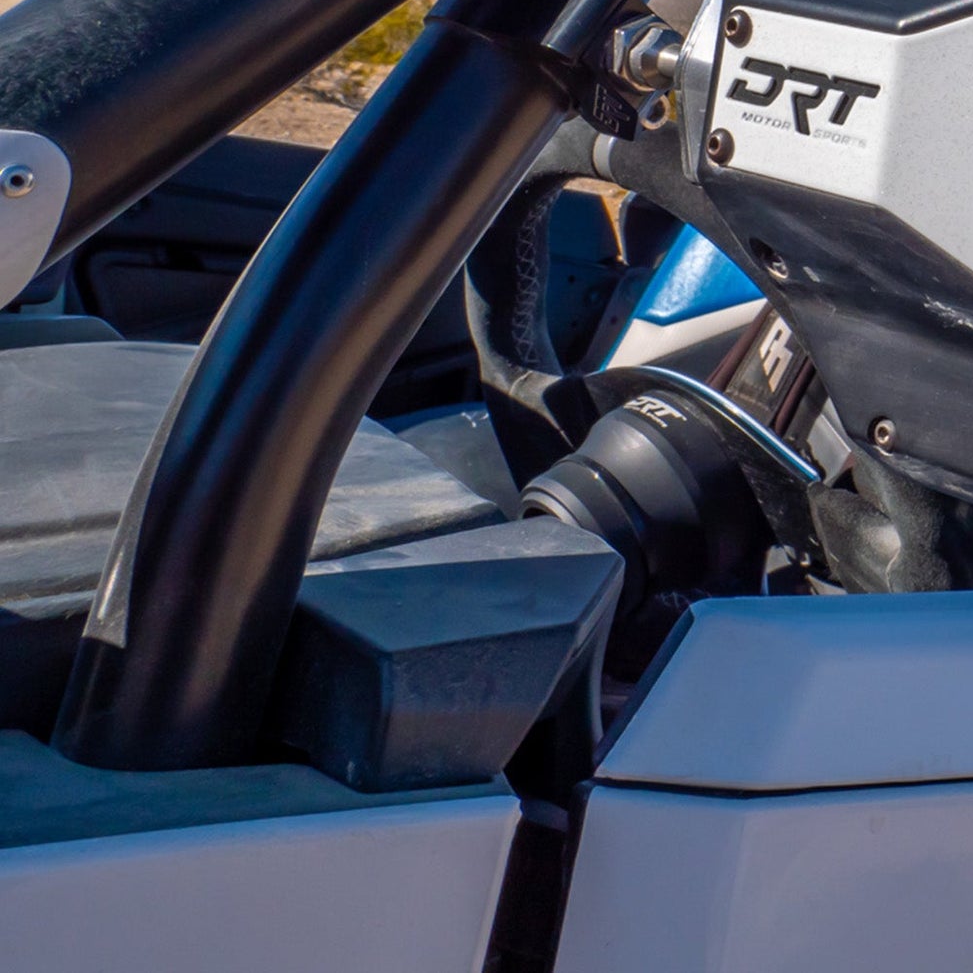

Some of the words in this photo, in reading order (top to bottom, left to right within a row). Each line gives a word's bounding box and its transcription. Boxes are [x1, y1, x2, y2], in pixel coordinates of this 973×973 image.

[726, 56, 881, 136] DRT
[741, 111, 792, 132] MOTOR
[812, 128, 868, 148] SPORTS
